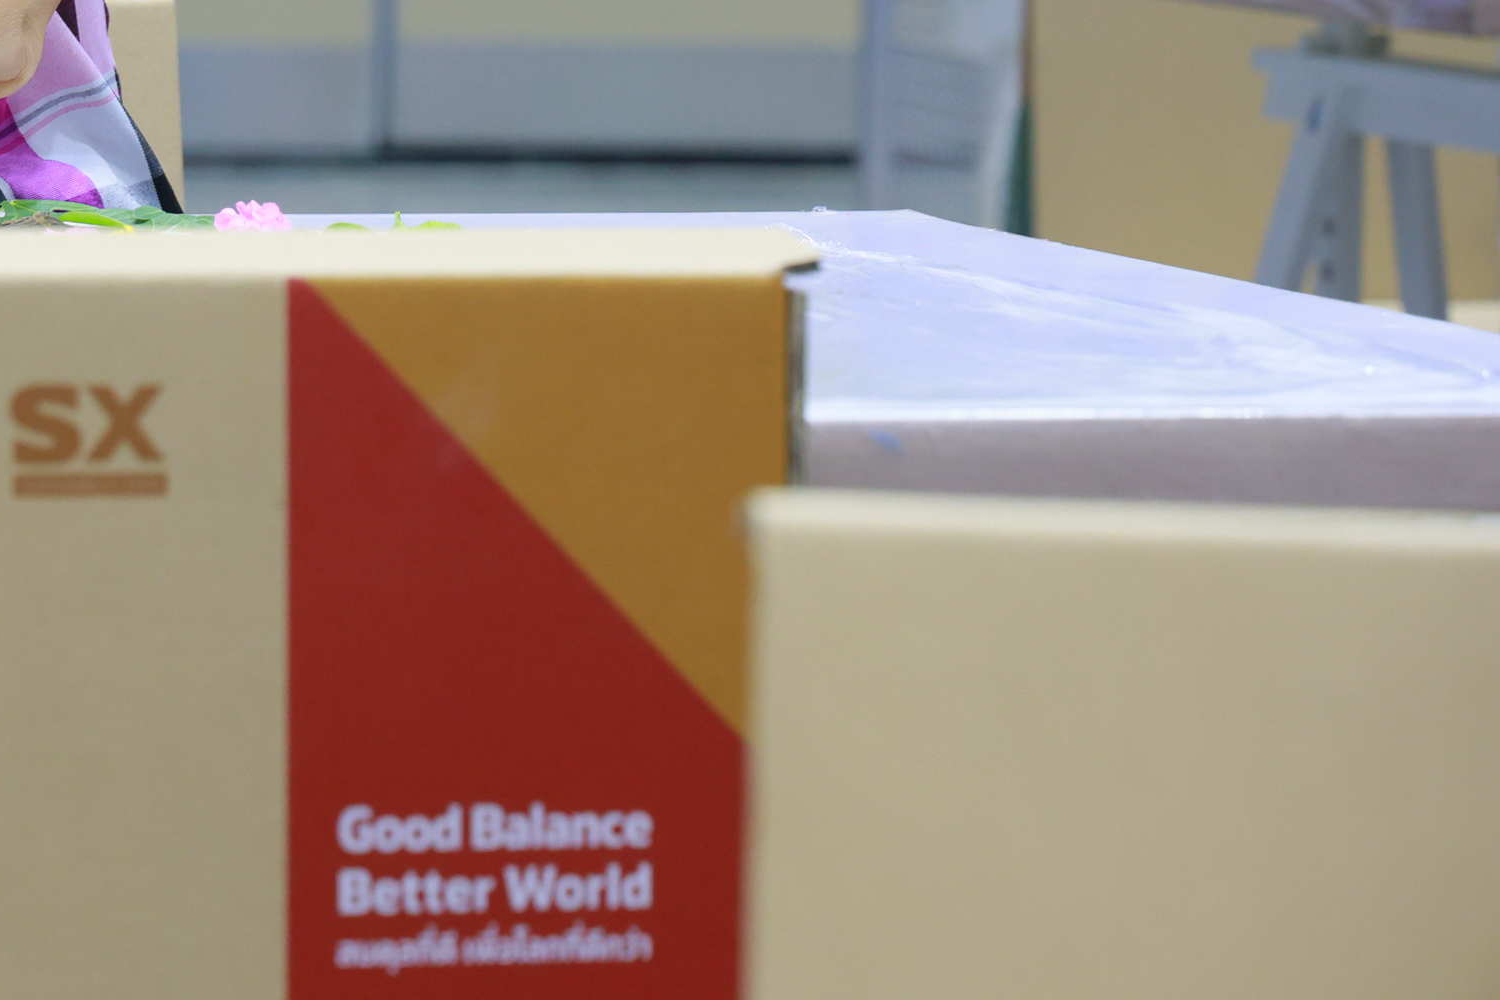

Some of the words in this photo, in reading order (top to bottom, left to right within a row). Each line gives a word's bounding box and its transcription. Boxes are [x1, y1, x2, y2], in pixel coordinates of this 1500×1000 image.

[9, 382, 164, 464] SX
[337, 802, 463, 854] Good
[469, 801, 654, 852] Balance
[335, 866, 496, 916] Better
[503, 860, 654, 913] World
